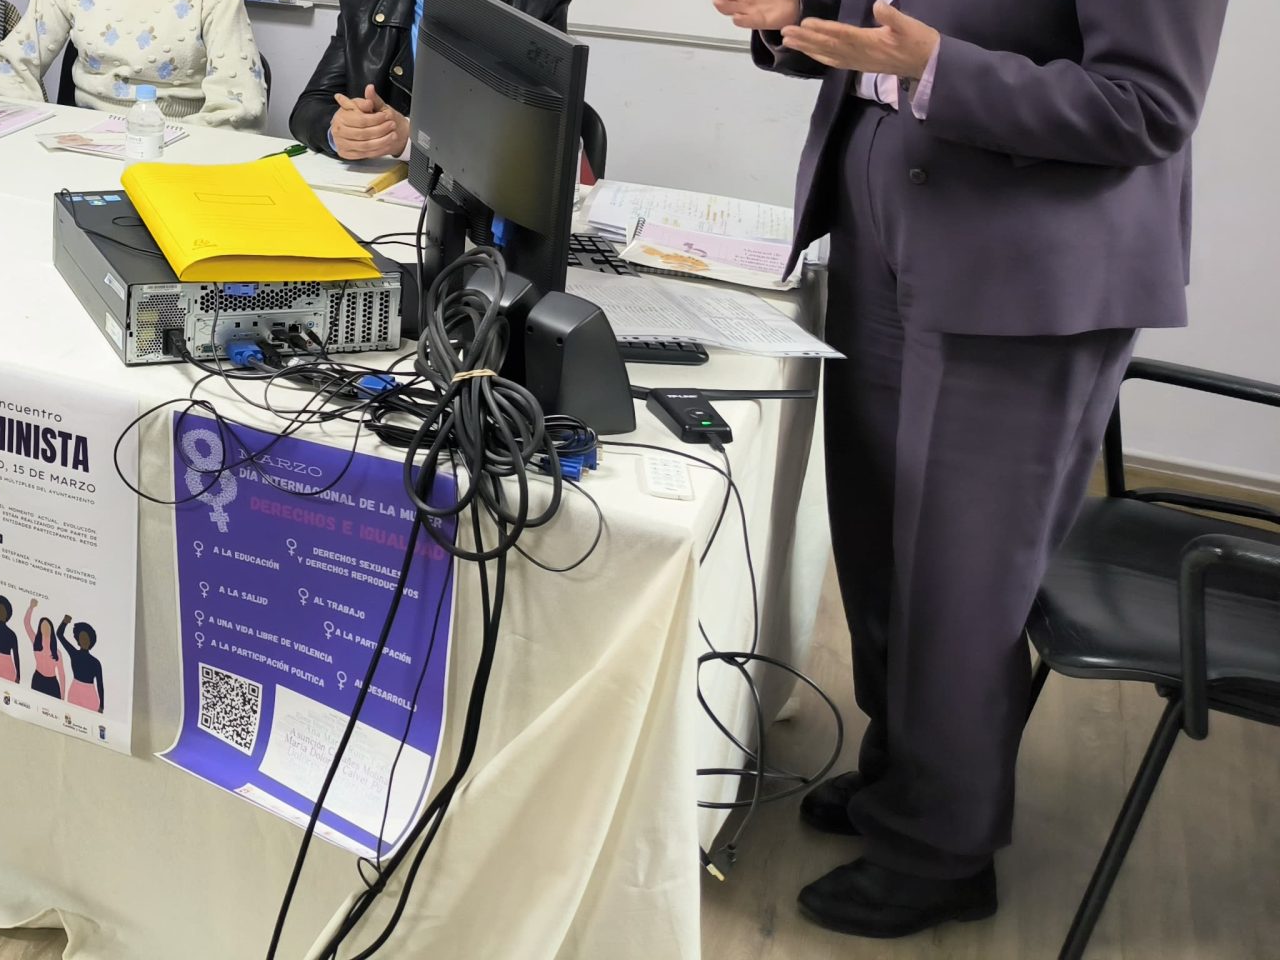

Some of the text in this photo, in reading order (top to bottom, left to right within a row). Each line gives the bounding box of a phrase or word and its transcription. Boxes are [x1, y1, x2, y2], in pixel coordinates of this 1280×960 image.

[238, 448, 322, 477] MARZO
[13, 464, 25, 475] 15
[30, 468, 45, 480] DE
[50, 474, 96, 493] MARZO
[49, 489, 95, 505] AYUNTAMIENTO
[239, 468, 258, 482] DÍA
[360, 497, 375, 511] DE
[380, 503, 395, 517] LA
[250, 496, 336, 531] DERECHOS
[342, 520, 353, 535] E
[213, 546, 280, 570] A LA EDUCACIÓN
[297, 556, 303, 564] Y
[306, 558, 349, 576] DERECHOS
[313, 547, 357, 566] DERECHOS
[219, 586, 268, 606] A LA SALUD
[313, 596, 366, 619] AL TRABAJO
[217, 618, 233, 629] UNA
[235, 623, 254, 635] VIDA
[256, 630, 279, 643] LIBRE
[280, 637, 291, 648] DE
[293, 641, 333, 664] VIOLENCIA
[335, 628, 341, 636] A
[343, 630, 353, 641] LA
[210, 639, 325, 687] A LA PARTICIPACIÓN POLITICA
